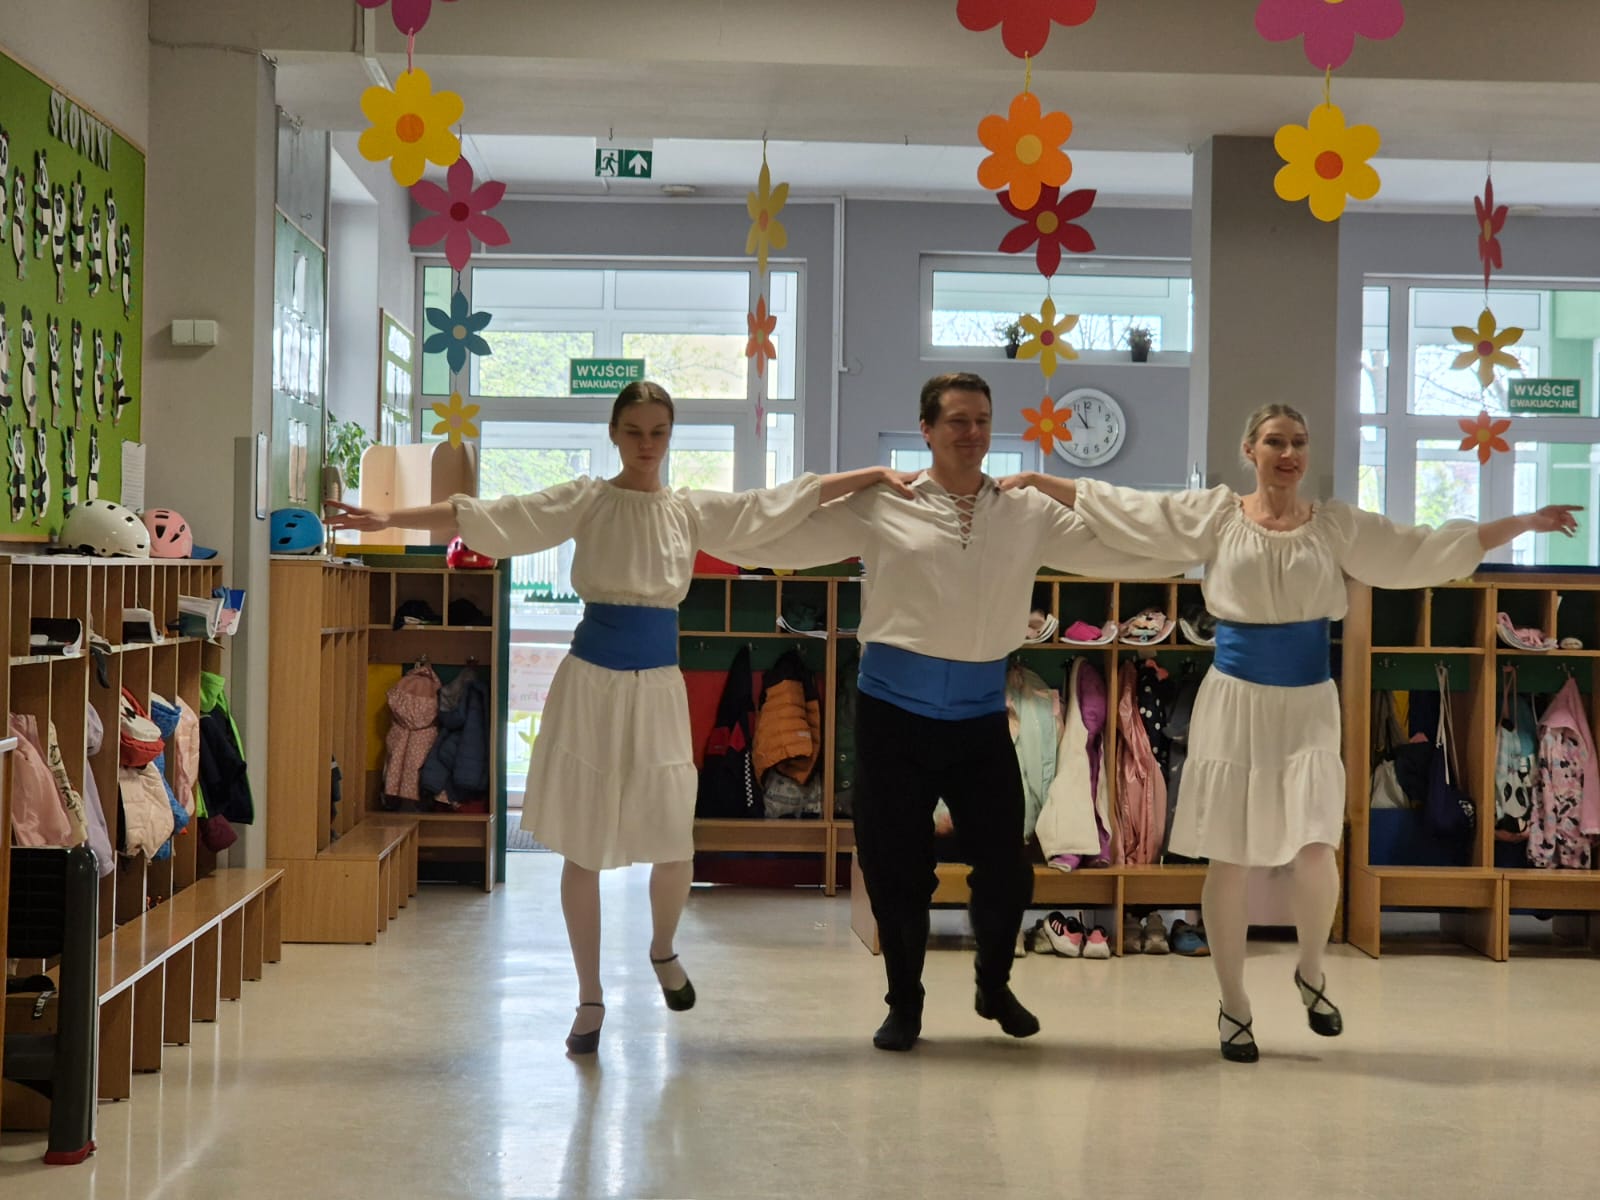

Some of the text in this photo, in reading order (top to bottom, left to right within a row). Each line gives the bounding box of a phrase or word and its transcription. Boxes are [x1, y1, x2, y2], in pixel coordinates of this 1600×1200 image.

[576, 362, 639, 377] WYJŚCIE
[1514, 382, 1575, 397] WYJŚCIE
[1510, 399, 1578, 408] EWAKUACYJNE
